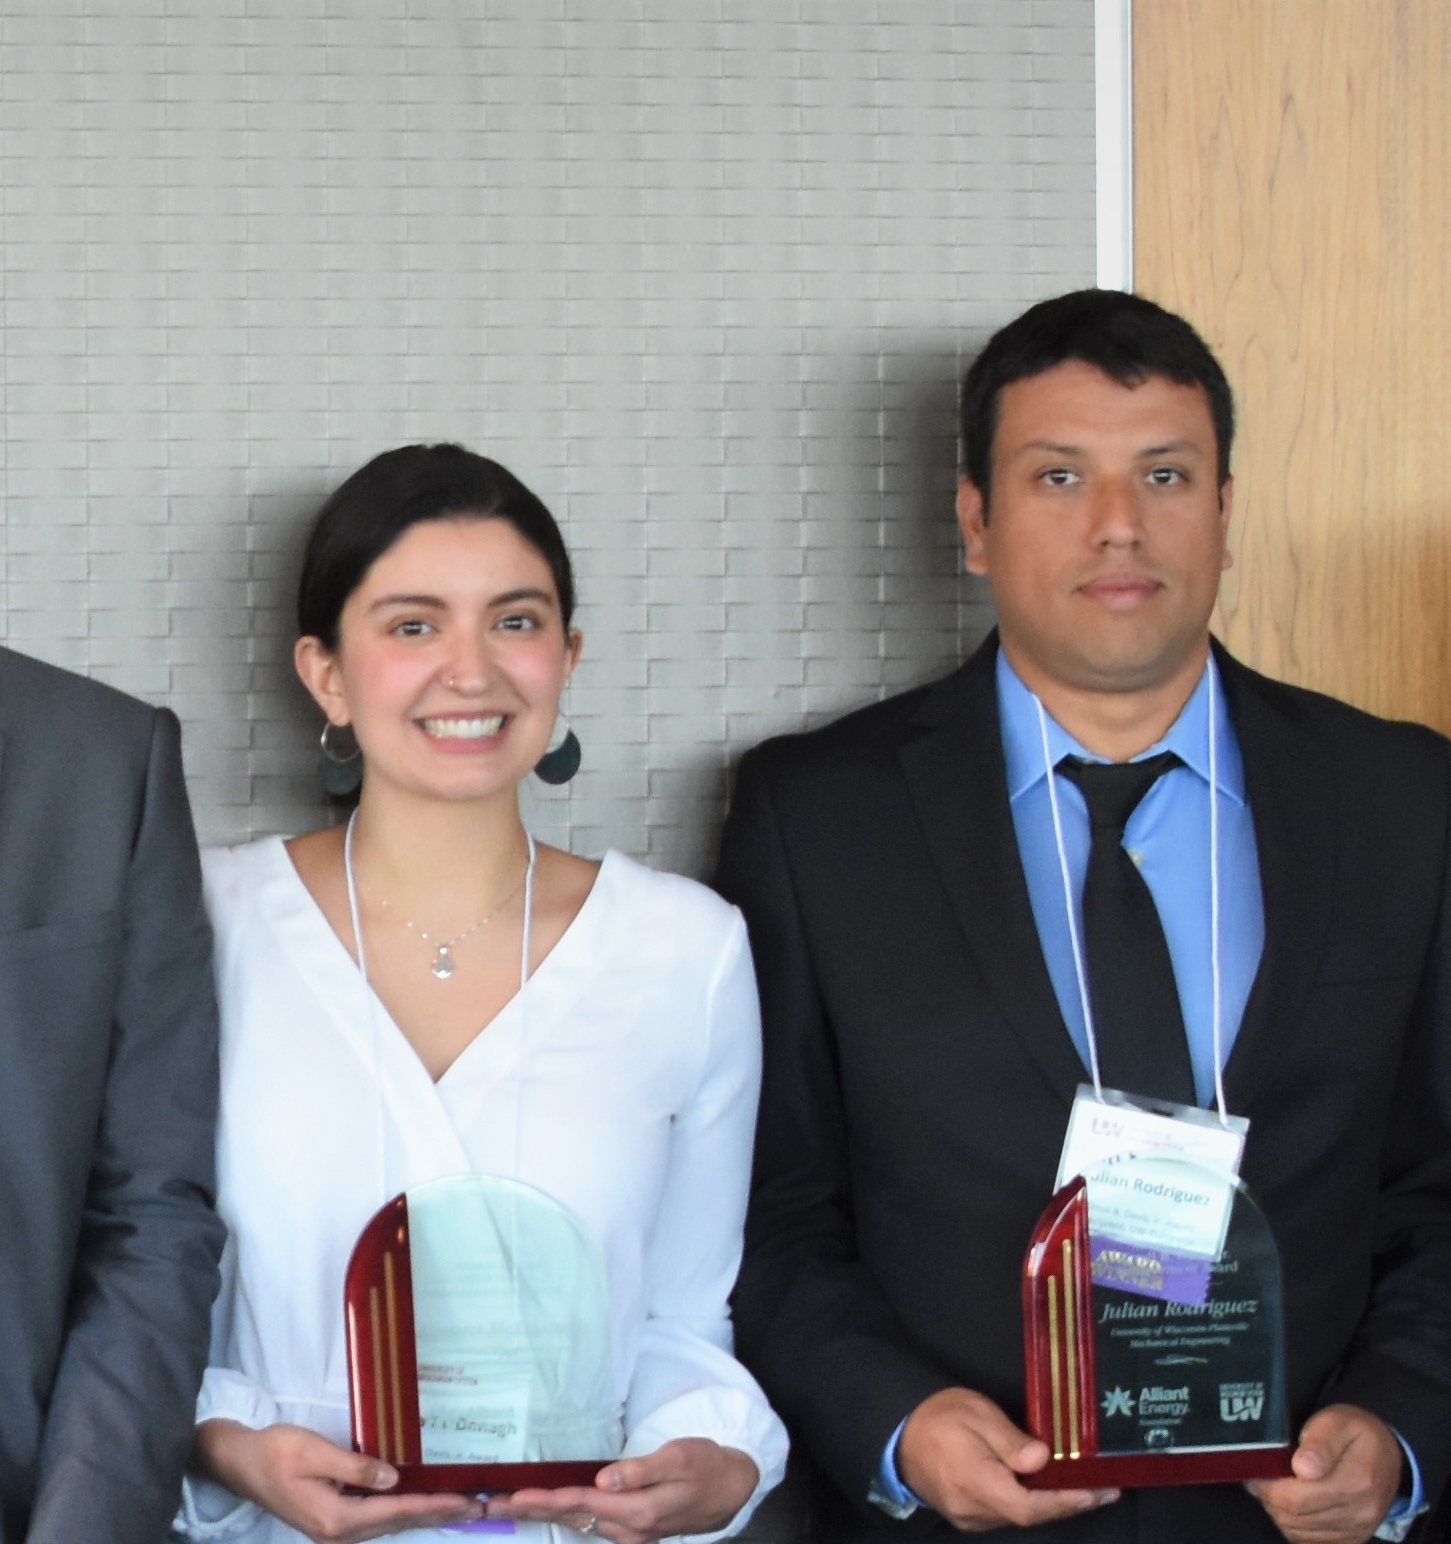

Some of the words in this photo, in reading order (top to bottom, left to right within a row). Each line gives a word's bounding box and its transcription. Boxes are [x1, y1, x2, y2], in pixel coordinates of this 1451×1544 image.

[1133, 1178, 1210, 1206] Rodriguez
[1098, 1302, 1159, 1324] Julian
[1164, 1298, 1259, 1318] Rodriguez
[1140, 1385, 1188, 1402] Alliant
[1139, 1402, 1188, 1417] Energy
[1220, 1396, 1264, 1422] UW
